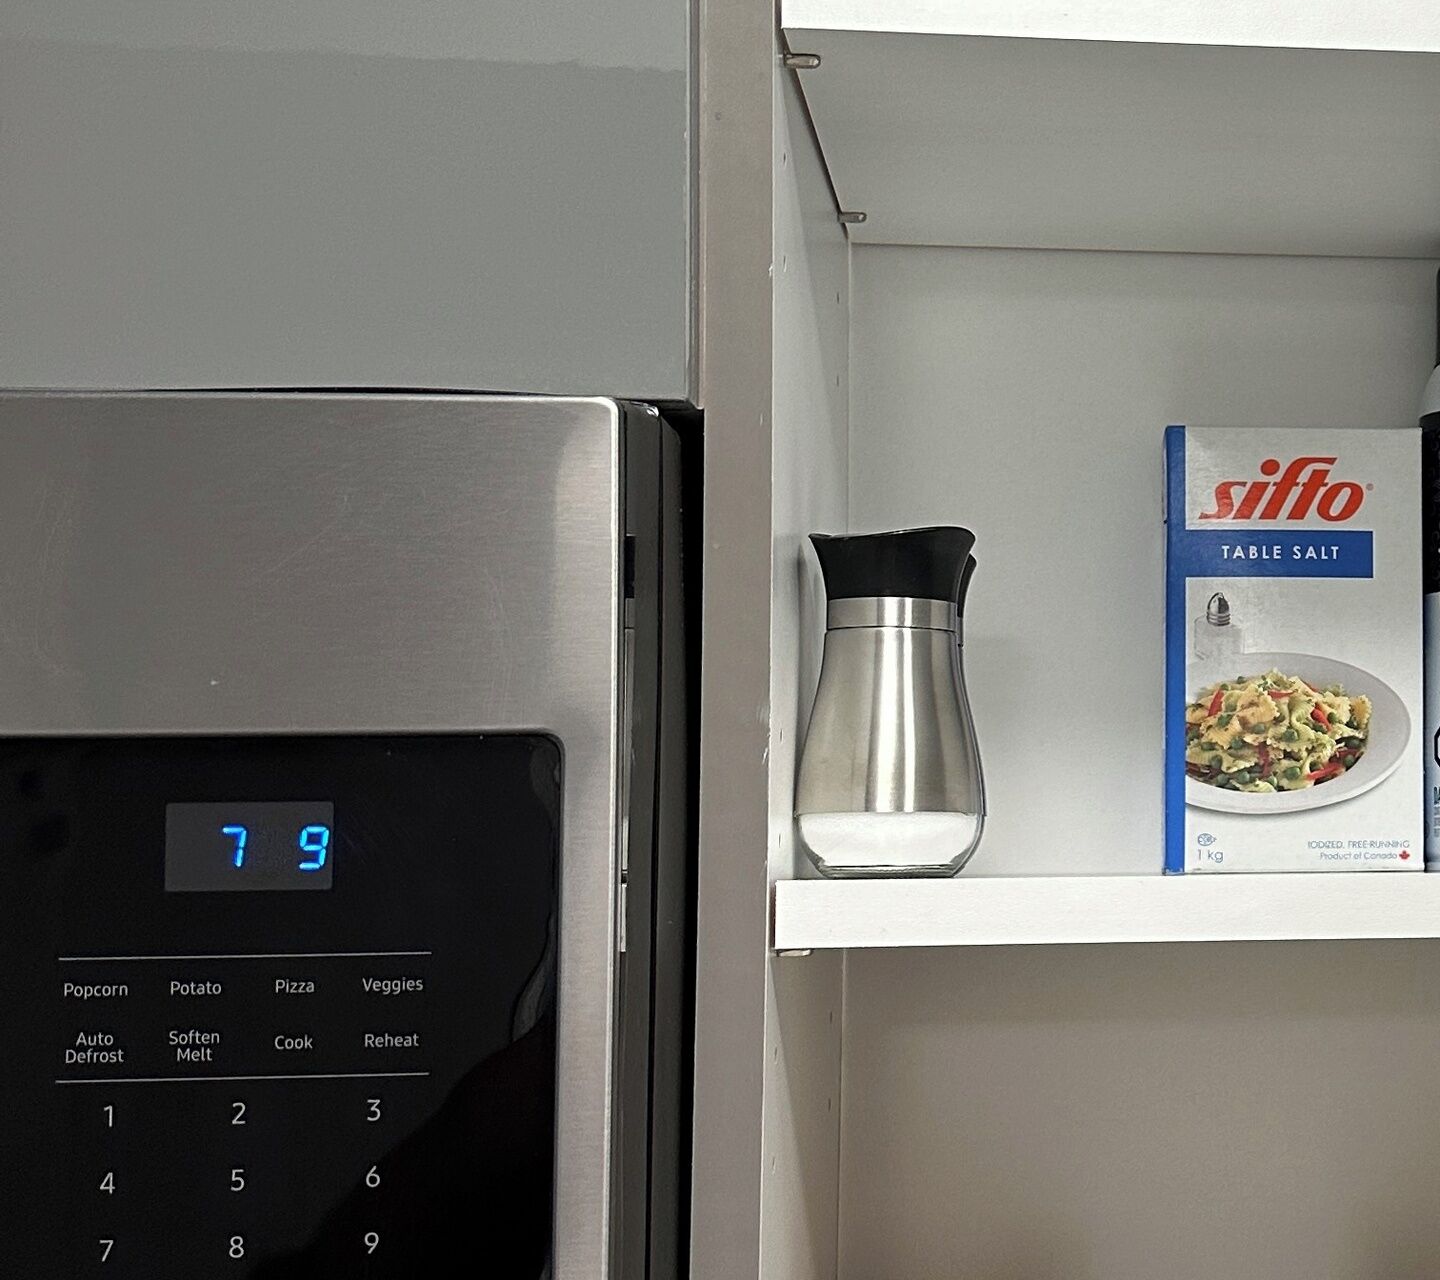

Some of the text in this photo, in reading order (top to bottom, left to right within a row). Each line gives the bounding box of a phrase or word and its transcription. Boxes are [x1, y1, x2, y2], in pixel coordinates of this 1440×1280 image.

[1198, 457, 1364, 522] sifto
[1221, 545, 1340, 560] TABLE SALT
[222, 825, 330, 870] 7 9
[1197, 849, 1224, 863] 1 kg
[1320, 851, 1351, 860] Product
[64, 982, 128, 1000] Popcorn
[170, 981, 222, 995] Potato
[275, 979, 315, 994] Pizza
[362, 976, 424, 995] Veggies
[75, 1031, 114, 1046] Auto
[169, 1029, 220, 1045] Soften
[274, 1034, 313, 1050] Cook
[364, 1032, 419, 1048] Reheat
[65, 1048, 124, 1064] Defrost
[176, 1046, 213, 1062] Melt
[103, 1105, 113, 1127] 1
[231, 1102, 246, 1125] 2
[367, 1099, 381, 1122] 3
[99, 1172, 116, 1194] 4
[230, 1169, 245, 1192] 5
[365, 1165, 381, 1188] 6
[99, 1239, 114, 1262] 7
[228, 1235, 245, 1259] 8
[364, 1232, 380, 1254] 9
